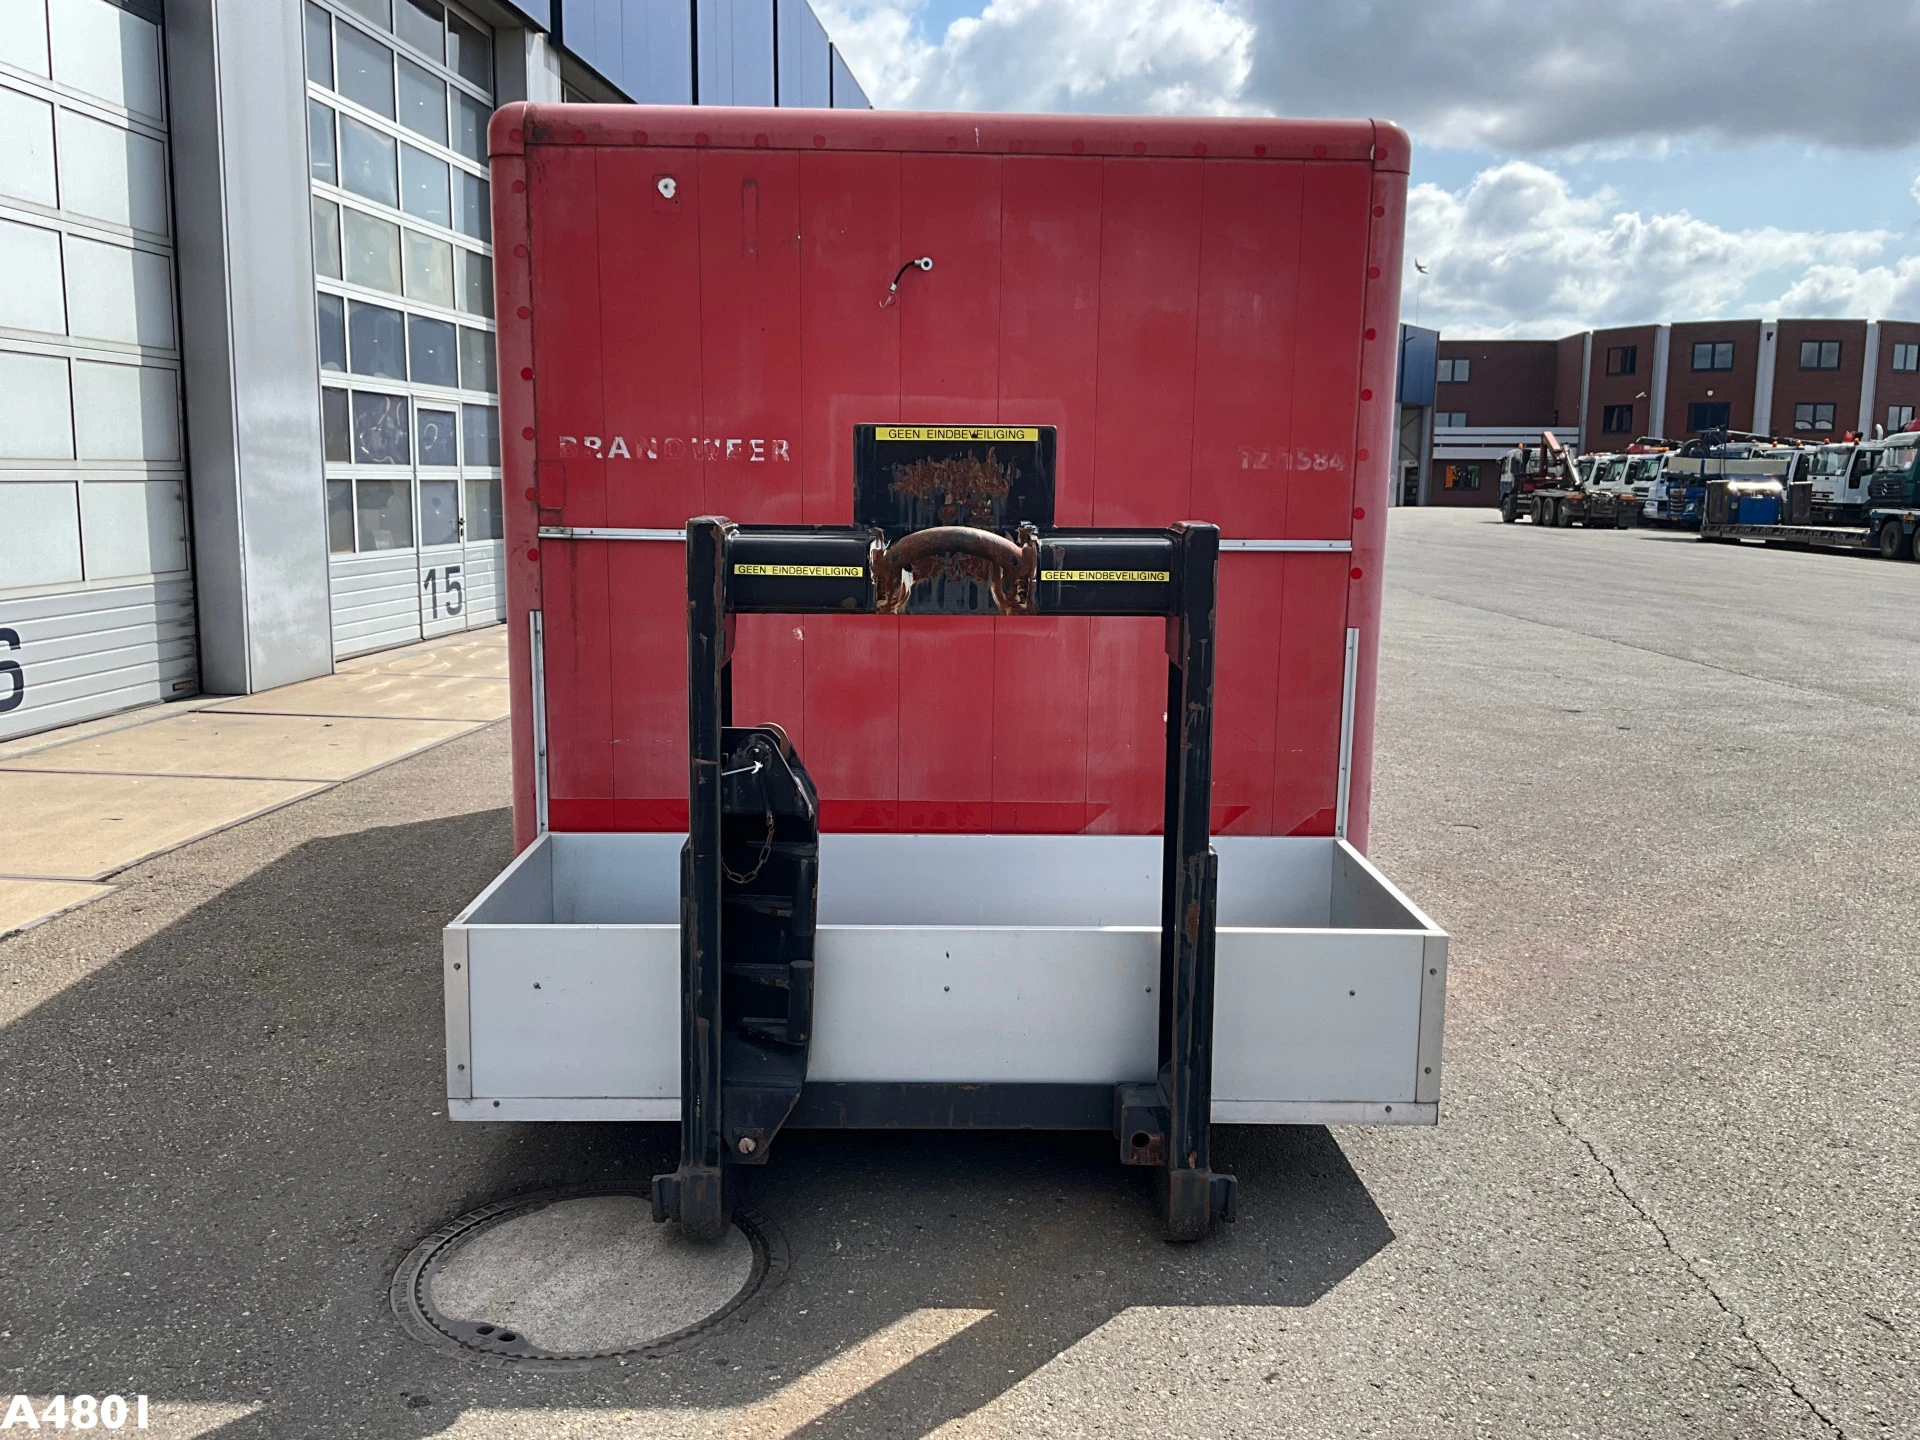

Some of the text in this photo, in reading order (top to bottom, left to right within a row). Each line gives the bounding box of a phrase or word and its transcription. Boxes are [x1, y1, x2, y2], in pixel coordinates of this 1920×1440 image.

[888, 429, 1025, 440] GEEN EINDBEVEILIGING
[738, 565, 859, 576] GEEN EINDBEVEILIGING
[1045, 571, 1165, 581] GEEN EINDBEVEILIGING
[423, 565, 463, 620] 15
